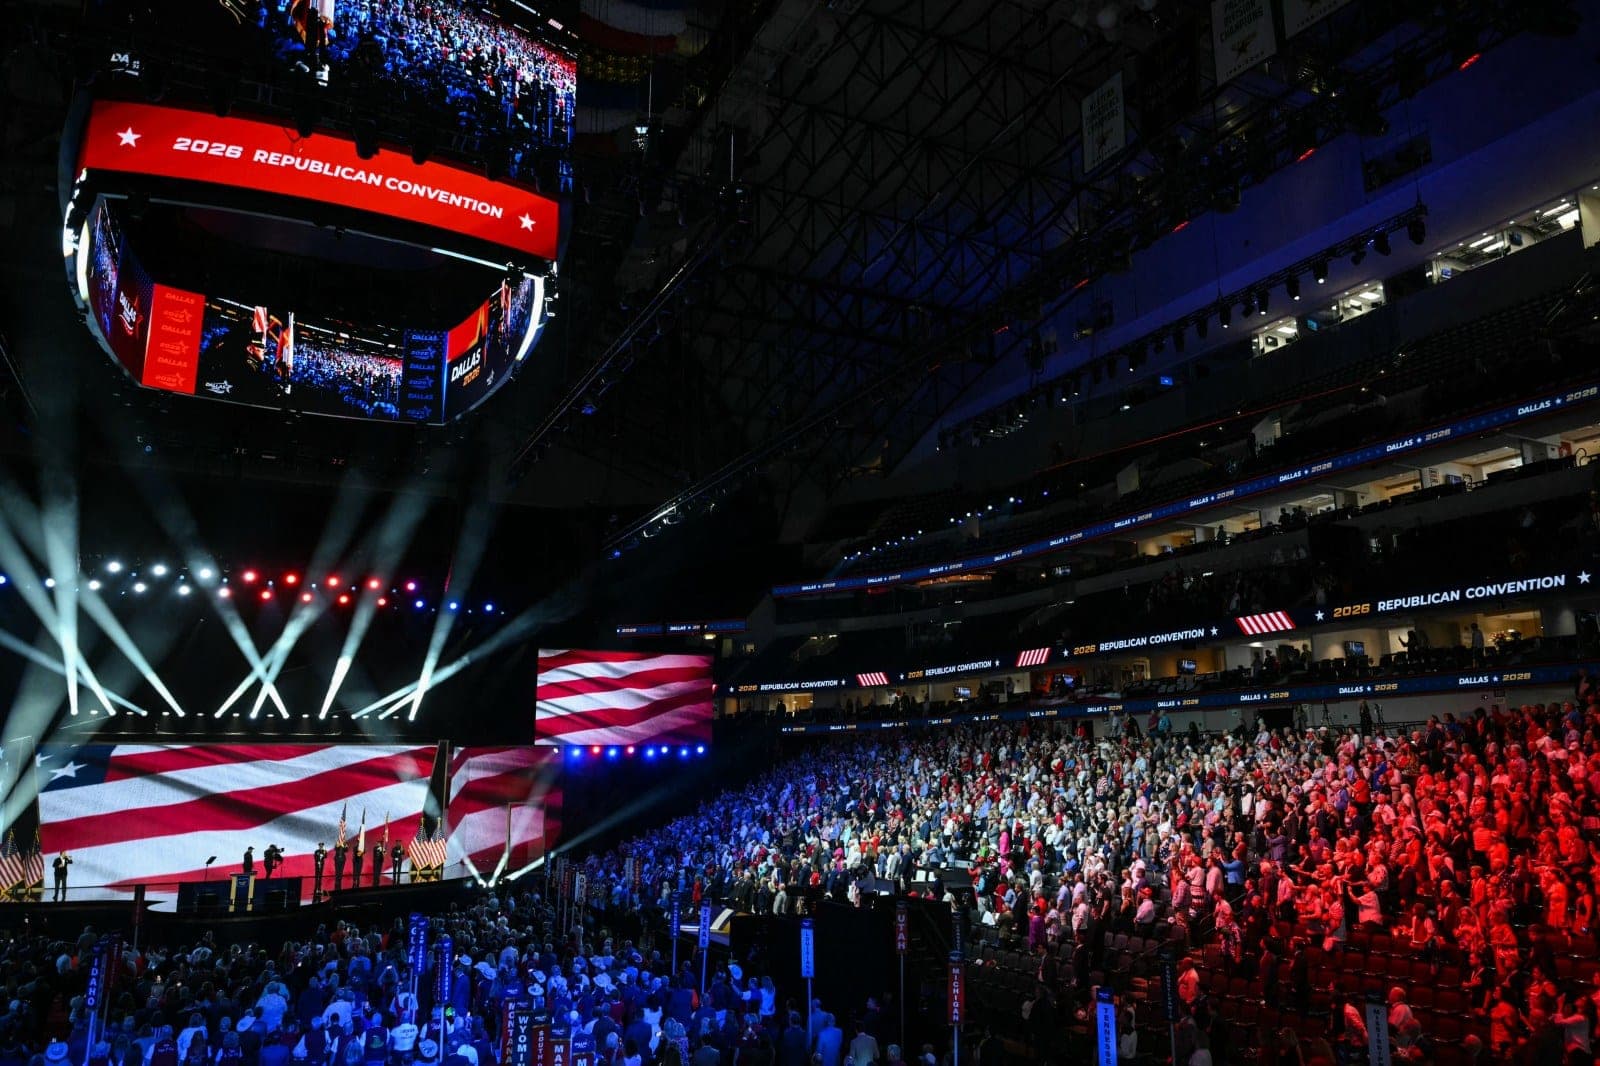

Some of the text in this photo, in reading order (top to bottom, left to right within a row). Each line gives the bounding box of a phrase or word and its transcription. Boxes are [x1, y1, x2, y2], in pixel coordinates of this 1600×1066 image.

[173, 138, 503, 218] 2026 REPUBLICAN CONVENTION
[164, 292, 196, 306] DALLAS
[160, 323, 193, 337] DALLAS
[156, 355, 189, 369] DALLAS
[451, 348, 481, 382] DALLAS
[1518, 387, 1597, 415] DALLAS 2026
[1386, 428, 1451, 452] DALLAS 2026
[1279, 470, 1302, 482] DALLAS
[1189, 496, 1209, 507] DALLAS
[1114, 518, 1131, 529] DALLAS
[1333, 575, 1565, 618] 2026 REPUBLICAN CONVENTION
[1073, 629, 1204, 655] 2026 REPUBLICAN CONVENTION
[925, 665, 956, 677] REPUBLICAN
[956, 659, 992, 672] CONVENTION
[738, 679, 838, 692] 2026 REPUBLICAN CONVENTION
[1458, 672, 1531, 685] DALLAS 2026
[1338, 683, 1399, 694] DALLAS 2026
[1240, 691, 1290, 702] DALLAS 2026
[1157, 700, 1176, 708] DALLAS
[897, 914, 906, 950] UTAH
[87, 956, 99, 1007] IDAHO
[952, 967, 960, 1022] MICHIGAN
